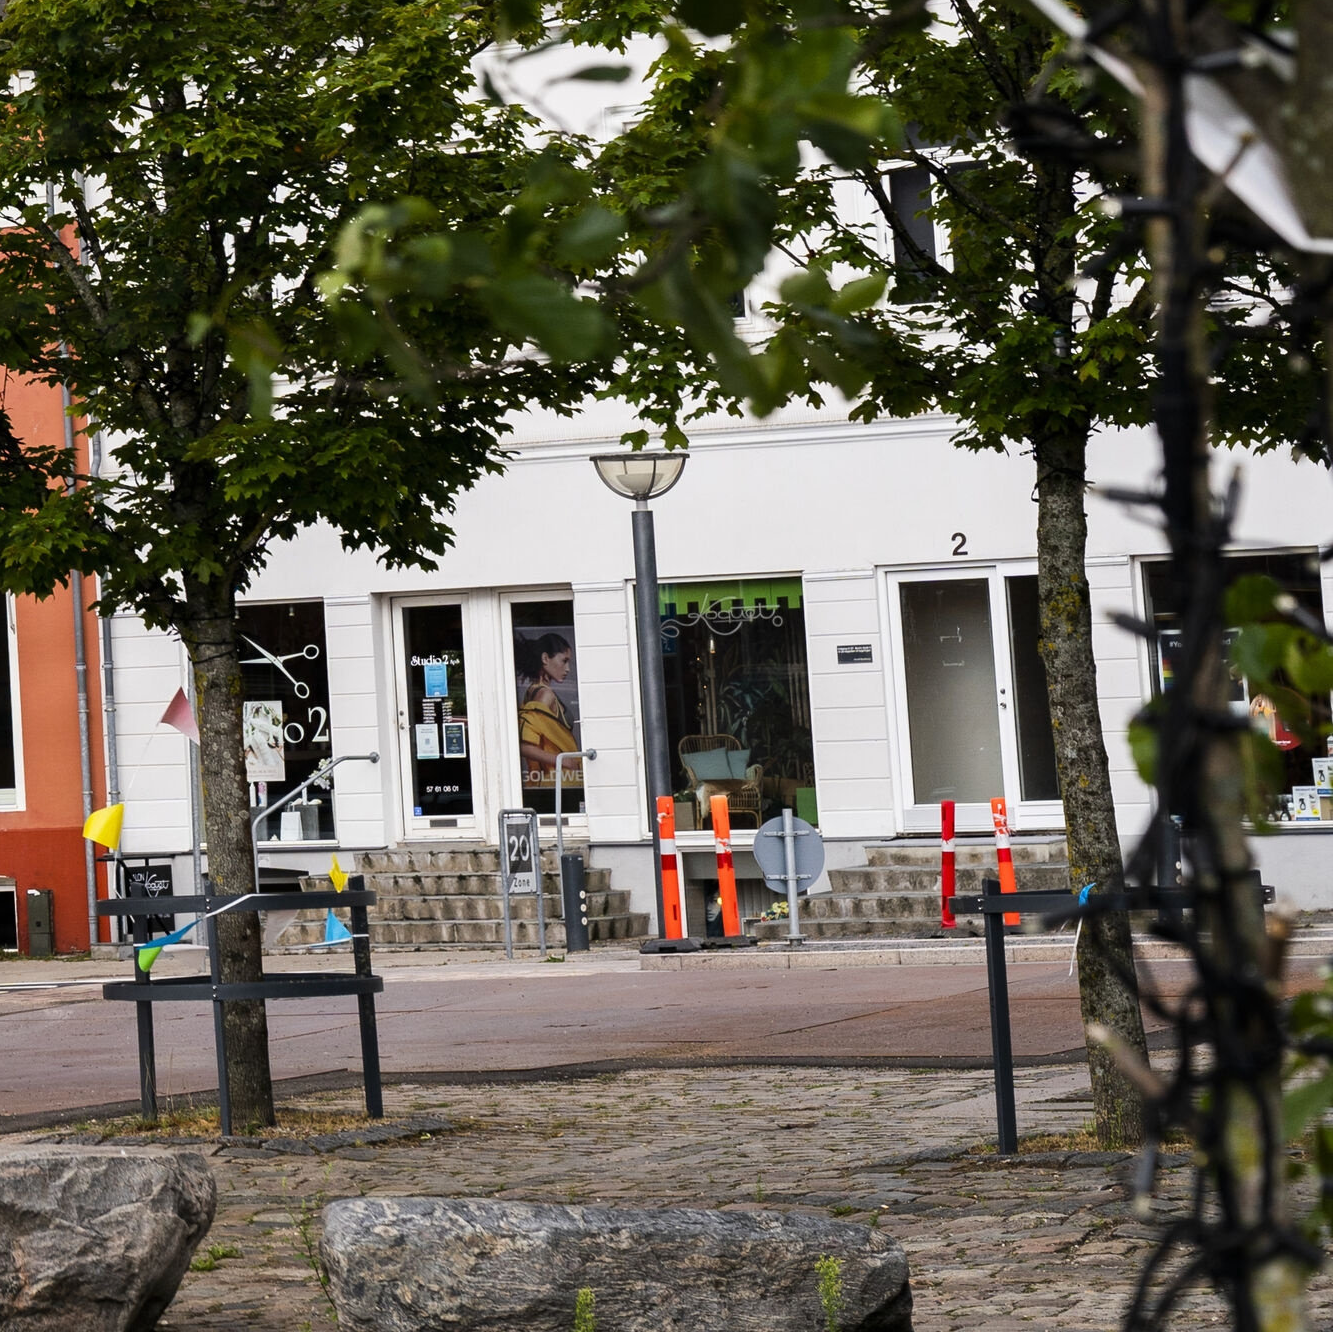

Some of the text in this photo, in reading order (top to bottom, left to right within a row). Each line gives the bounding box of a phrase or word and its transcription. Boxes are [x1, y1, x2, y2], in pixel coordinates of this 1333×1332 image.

[951, 532, 968, 556] 2
[411, 655, 442, 666] Studio
[442, 654, 449, 665] 2
[308, 706, 329, 742] 2
[509, 835, 529, 861] 20
[514, 877, 530, 887] Zone
